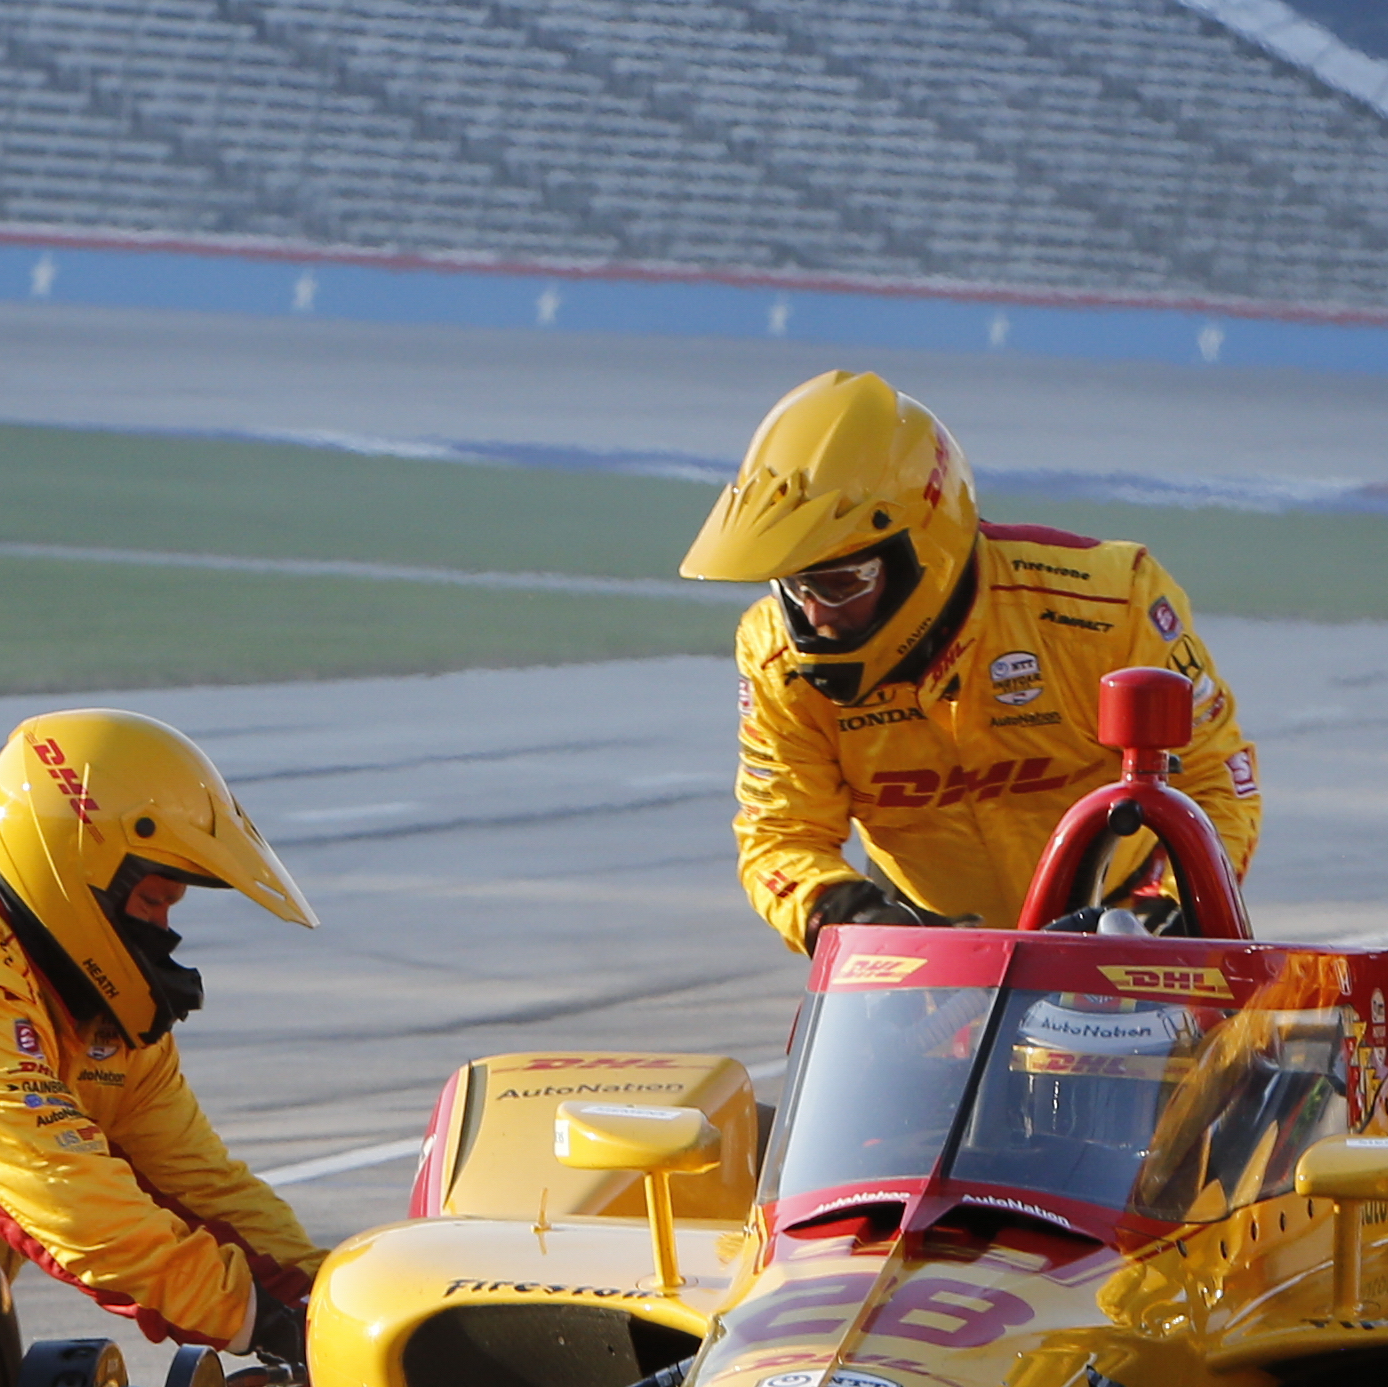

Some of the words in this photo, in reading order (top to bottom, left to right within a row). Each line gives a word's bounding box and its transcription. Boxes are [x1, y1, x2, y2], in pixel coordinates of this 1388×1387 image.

[1012, 558, 1091, 581] Firestone
[1010, 659, 1035, 671] NTT
[32, 737, 100, 826] DHL
[870, 757, 1070, 808] DHL
[82, 957, 121, 999] HEATH
[847, 959, 902, 983] DHL
[1121, 968, 1217, 991] DHL
[1041, 1016, 1153, 1039] AutoNation
[522, 1057, 681, 1071] DHL
[1045, 1052, 1127, 1075] DHL
[495, 1081, 686, 1102] AutoNation
[815, 1190, 911, 1214] AutoNation
[962, 1193, 1072, 1229] AutoNation
